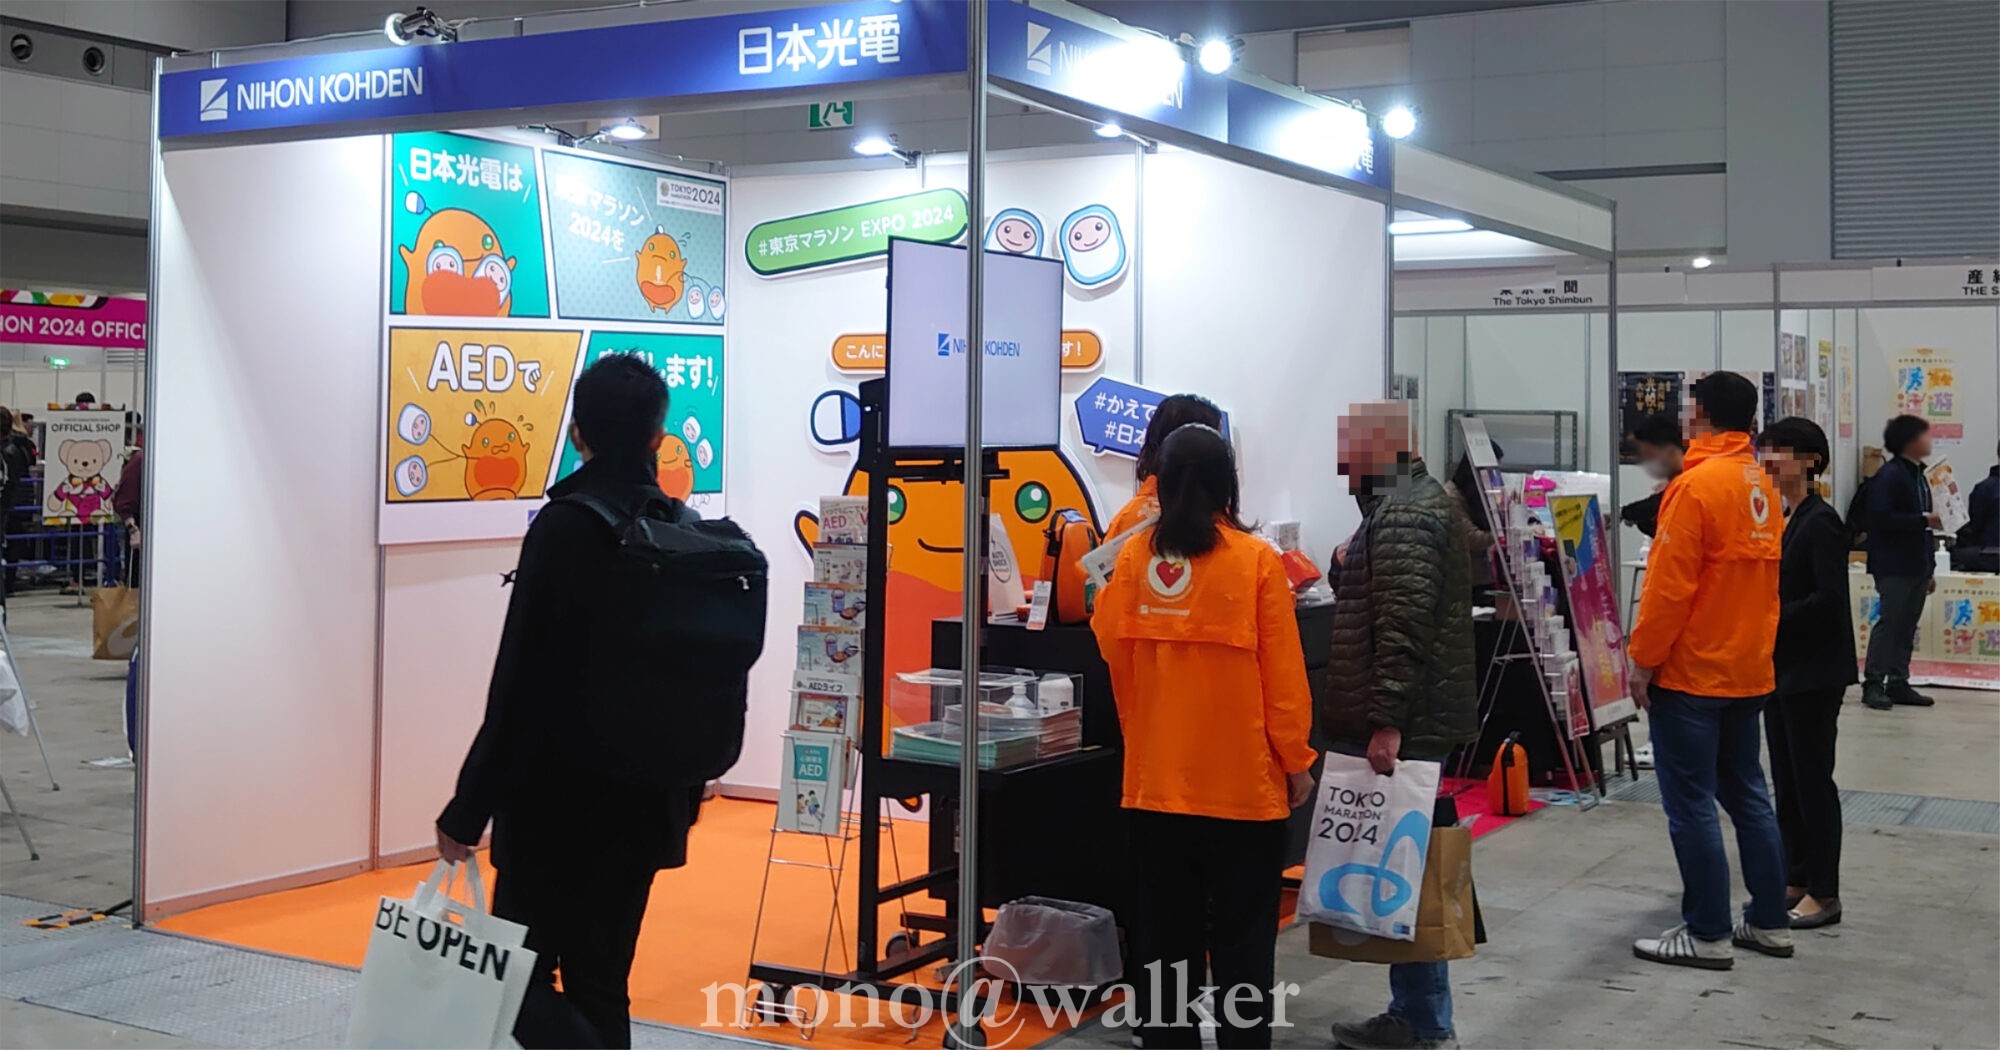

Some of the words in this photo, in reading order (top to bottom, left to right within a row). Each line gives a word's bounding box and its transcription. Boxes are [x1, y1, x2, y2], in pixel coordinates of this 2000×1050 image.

[738, 13, 901, 75] 日本光電
[236, 76, 314, 112] NIHON
[319, 66, 423, 104] KOHDEN
[410, 147, 524, 192] 日本光電は
[670, 183, 692, 195] TOKYO
[692, 187, 721, 206] 2024
[556, 174, 645, 227] マラソン
[568, 211, 625, 252] 2024を
[758, 225, 855, 257] #東京マラソン
[860, 213, 906, 238] EXPO
[911, 203, 955, 229] 2024
[1493, 296, 1512, 306] The
[1516, 296, 1546, 307] Tokyo
[1549, 295, 1593, 305] Shimbun
[1962, 286, 1987, 296] THE
[39, 316, 86, 337] 2024
[845, 344, 884, 359] こんに
[984, 340, 1021, 357] KOHDEN
[426, 340, 542, 393] AEDで
[51, 423, 93, 433] OFFICIAL
[96, 423, 121, 433] SHOP
[823, 515, 847, 530] AED
[798, 763, 823, 777] AED
[374, 896, 411, 939] BE
[416, 915, 511, 982] OPEN
